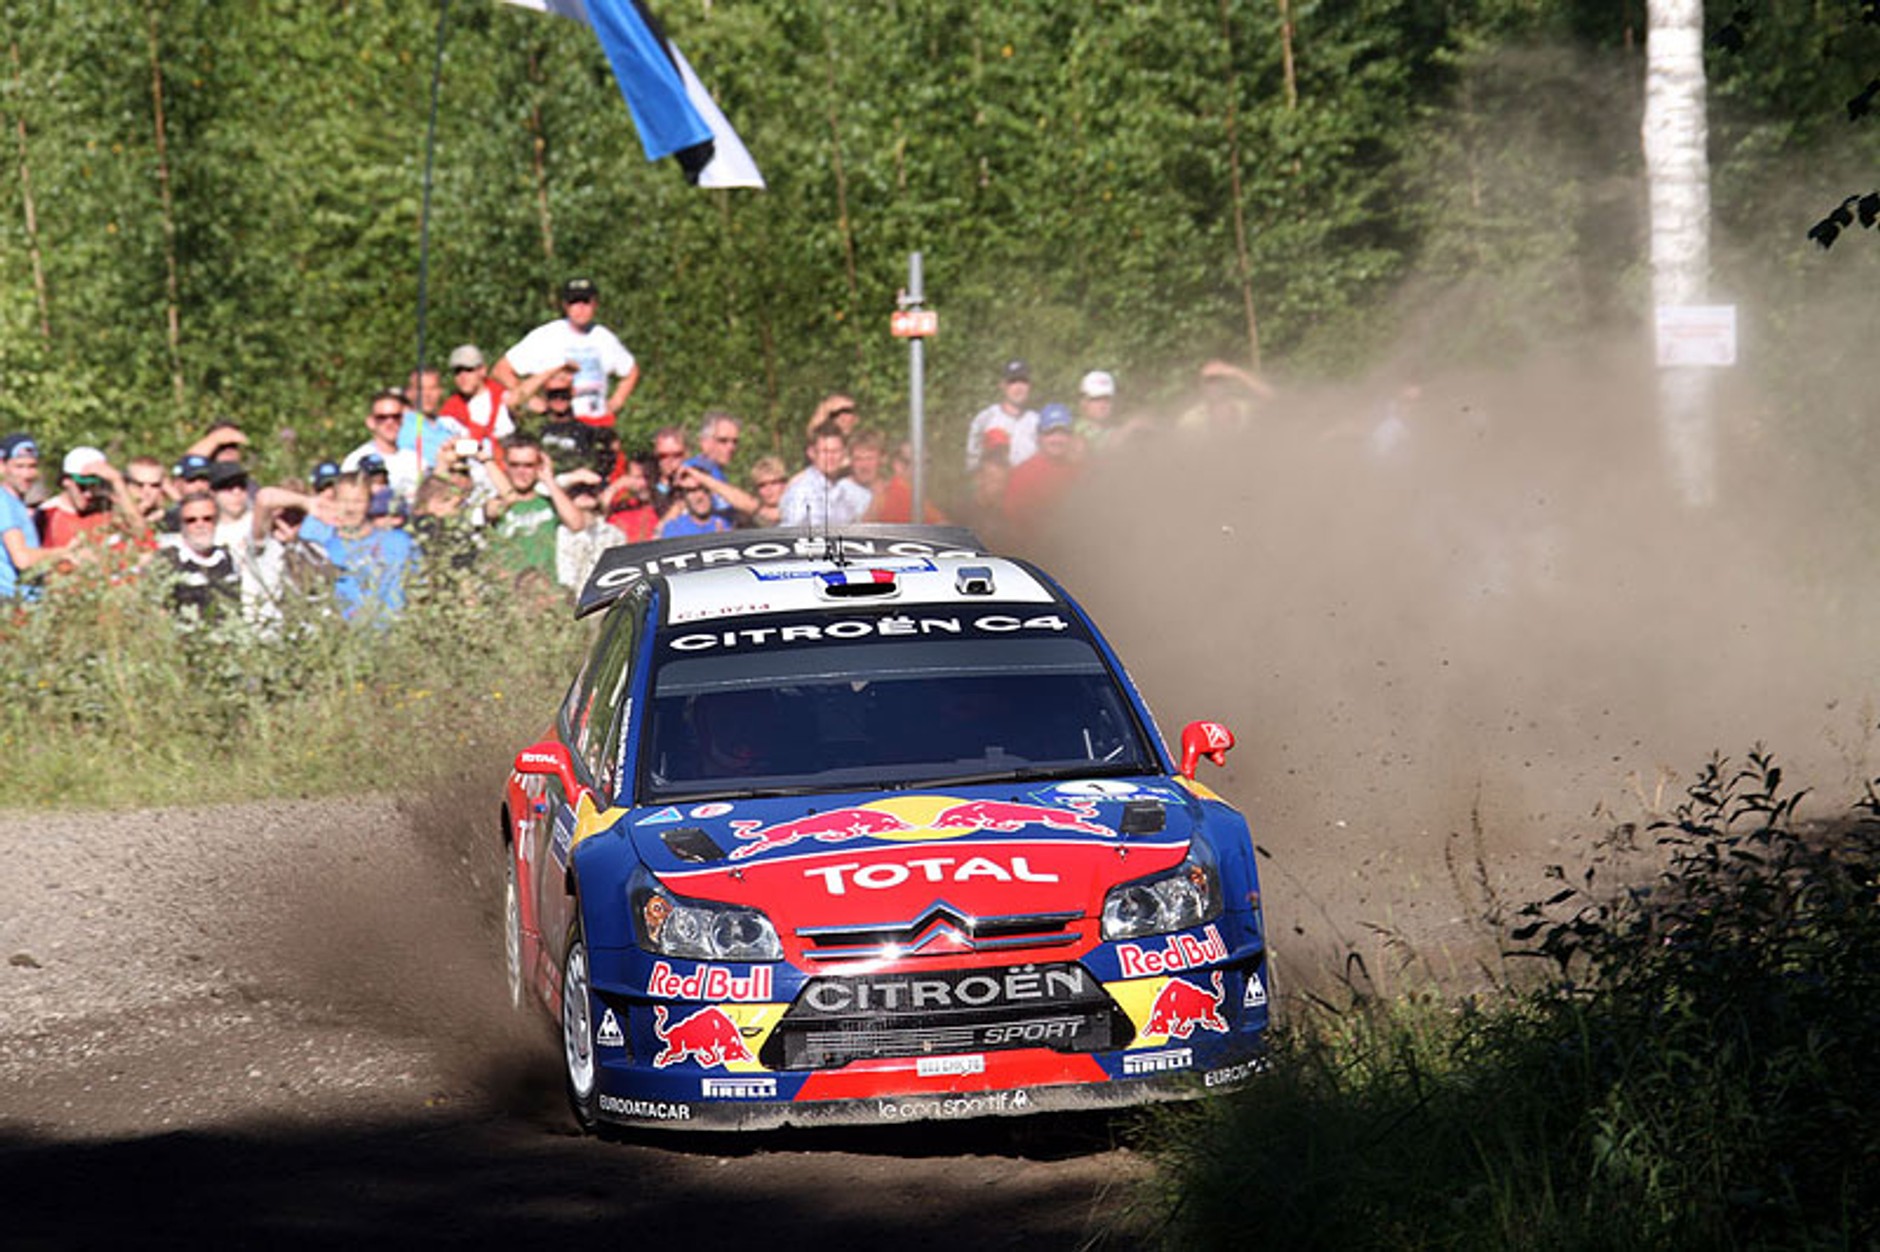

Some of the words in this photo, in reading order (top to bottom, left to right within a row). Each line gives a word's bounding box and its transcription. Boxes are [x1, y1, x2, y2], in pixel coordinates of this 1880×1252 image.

[597, 537, 875, 587] CITROËN
[669, 614, 961, 651] CITROËN
[973, 615, 1068, 632] C4
[520, 753, 559, 765] TOTAL
[804, 857, 1059, 895] TOTAL
[1119, 937, 1184, 976] Red
[1180, 925, 1228, 966] Bull
[649, 962, 704, 997] Red
[706, 967, 771, 1000] Bull
[805, 966, 1084, 1012] CITROËN
[984, 1018, 1081, 1044] SPORT
[1123, 1048, 1193, 1074] PIRELLI
[702, 1078, 777, 1097] PIRELLI
[878, 1100, 897, 1119] le
[943, 1092, 1008, 1118] sportif
